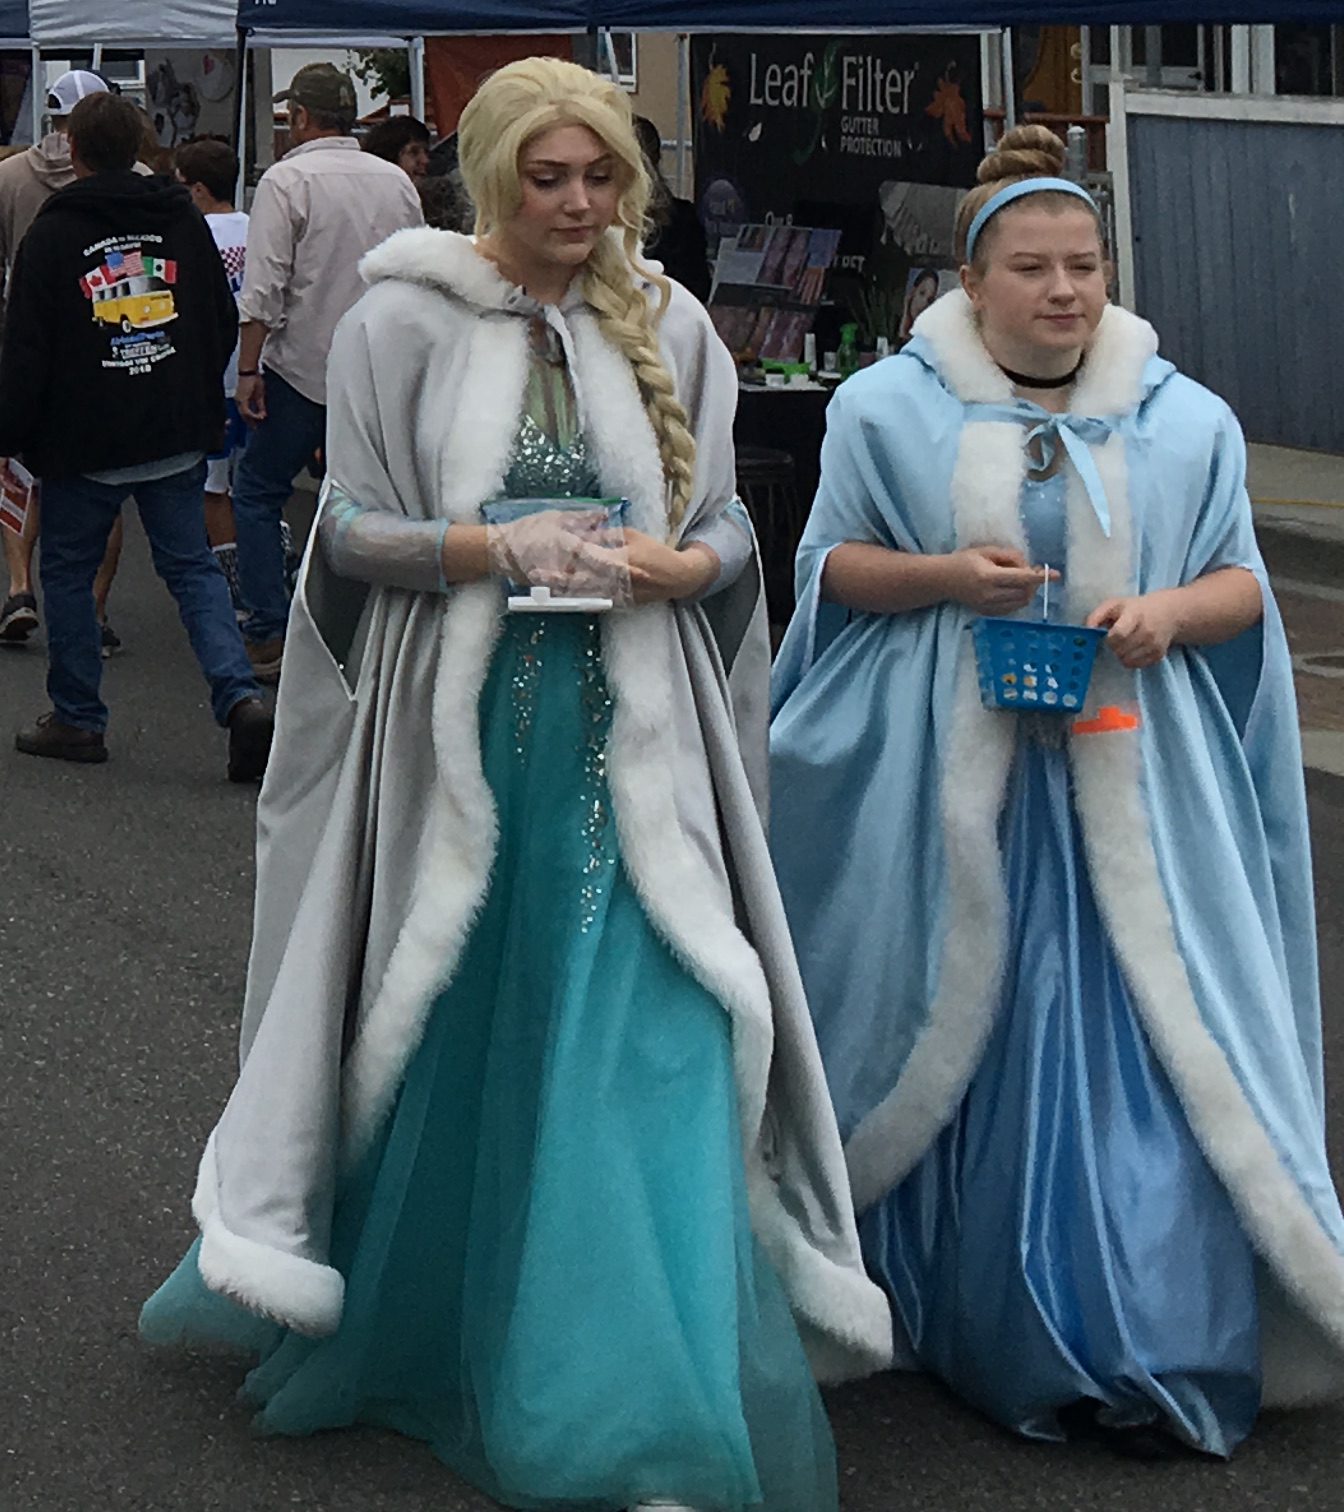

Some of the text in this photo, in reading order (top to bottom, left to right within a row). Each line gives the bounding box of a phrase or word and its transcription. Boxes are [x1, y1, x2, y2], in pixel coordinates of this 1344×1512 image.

[749, 52, 915, 114] Leaf Filter
[840, 116, 879, 135] GUTTER
[840, 136, 902, 157] PROTECTION
